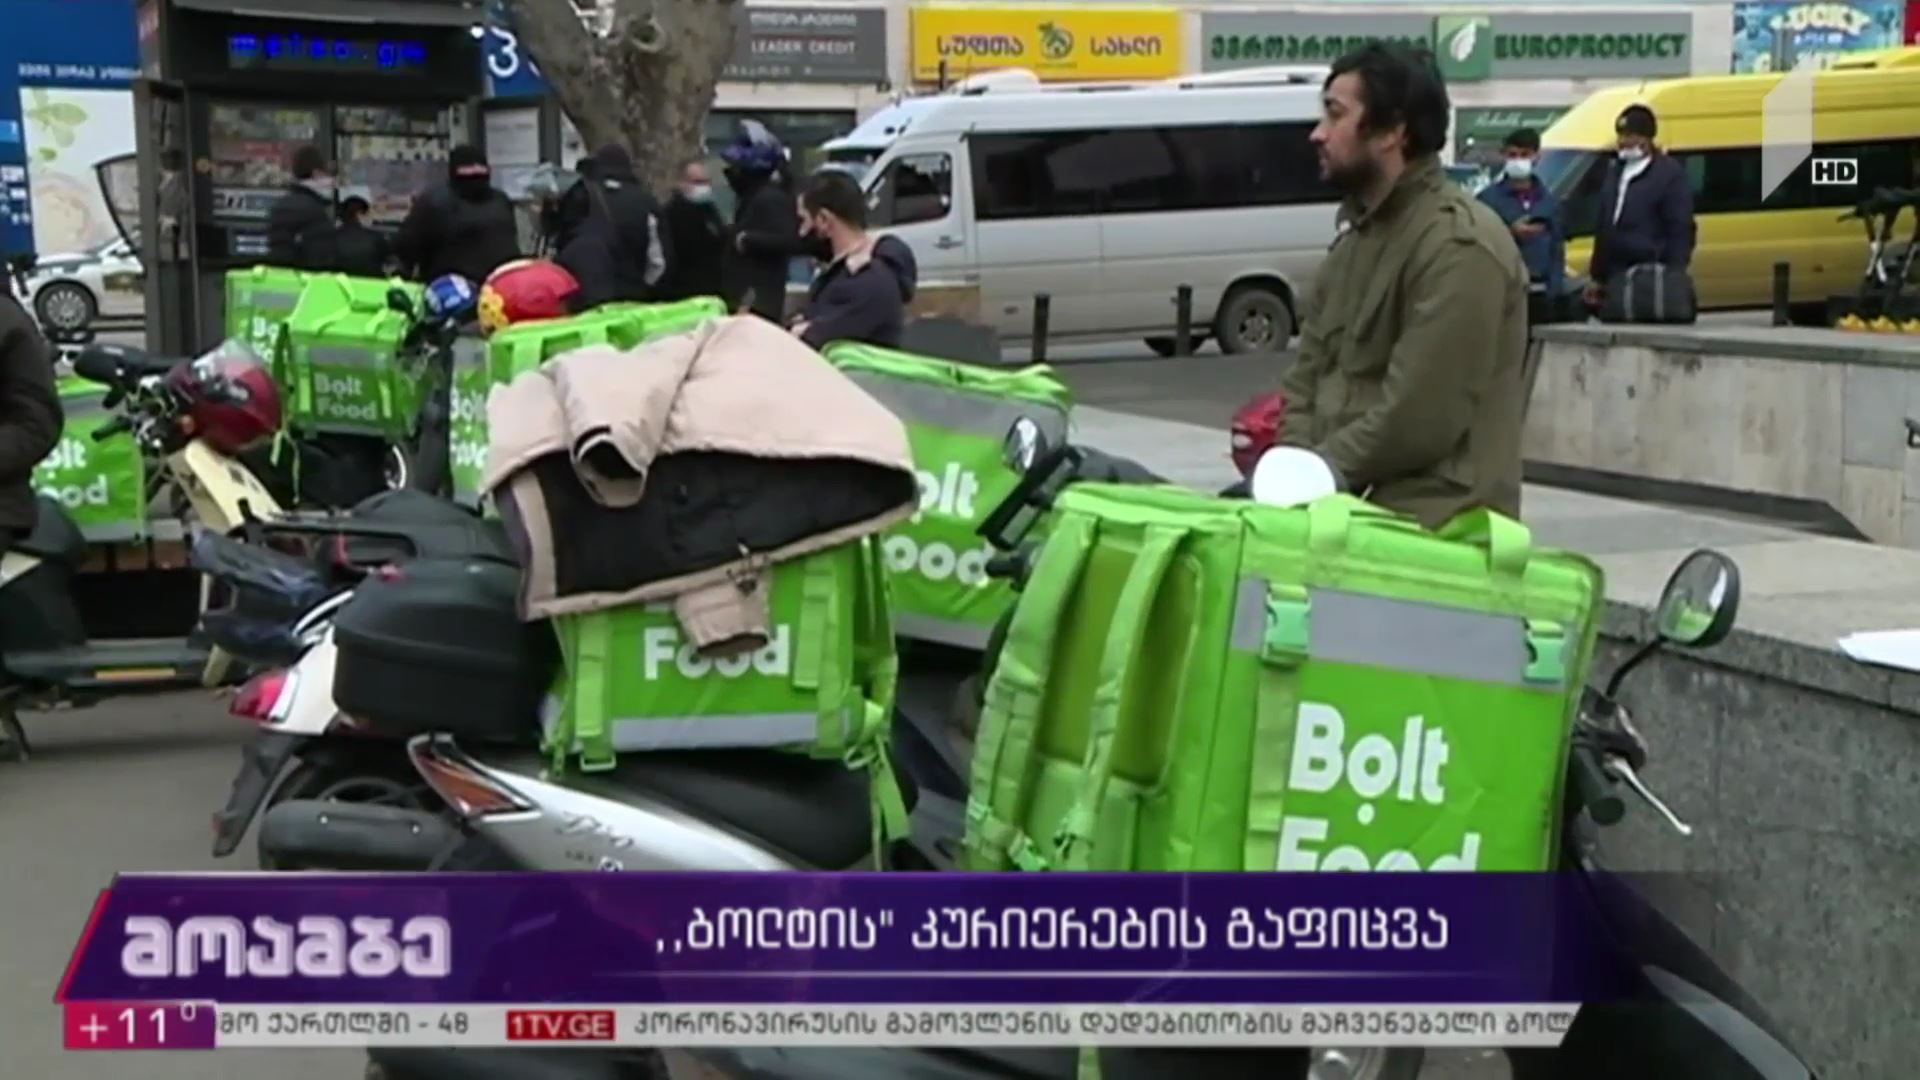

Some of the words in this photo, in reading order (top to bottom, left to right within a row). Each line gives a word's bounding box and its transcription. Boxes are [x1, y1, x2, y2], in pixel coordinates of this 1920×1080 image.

[751, 40, 801, 54] LEADER
[808, 40, 855, 54] CREDIT
[936, 35, 1024, 57] სუფთა
[1089, 35, 1162, 57] სახლი
[1494, 32, 1687, 60] EUROPRODUCT
[313, 373, 363, 397] Bolt
[316, 401, 378, 421] Food
[911, 461, 980, 525] olt
[883, 534, 991, 588] ood
[643, 623, 791, 681] Food
[1287, 700, 1450, 826] Bolt
